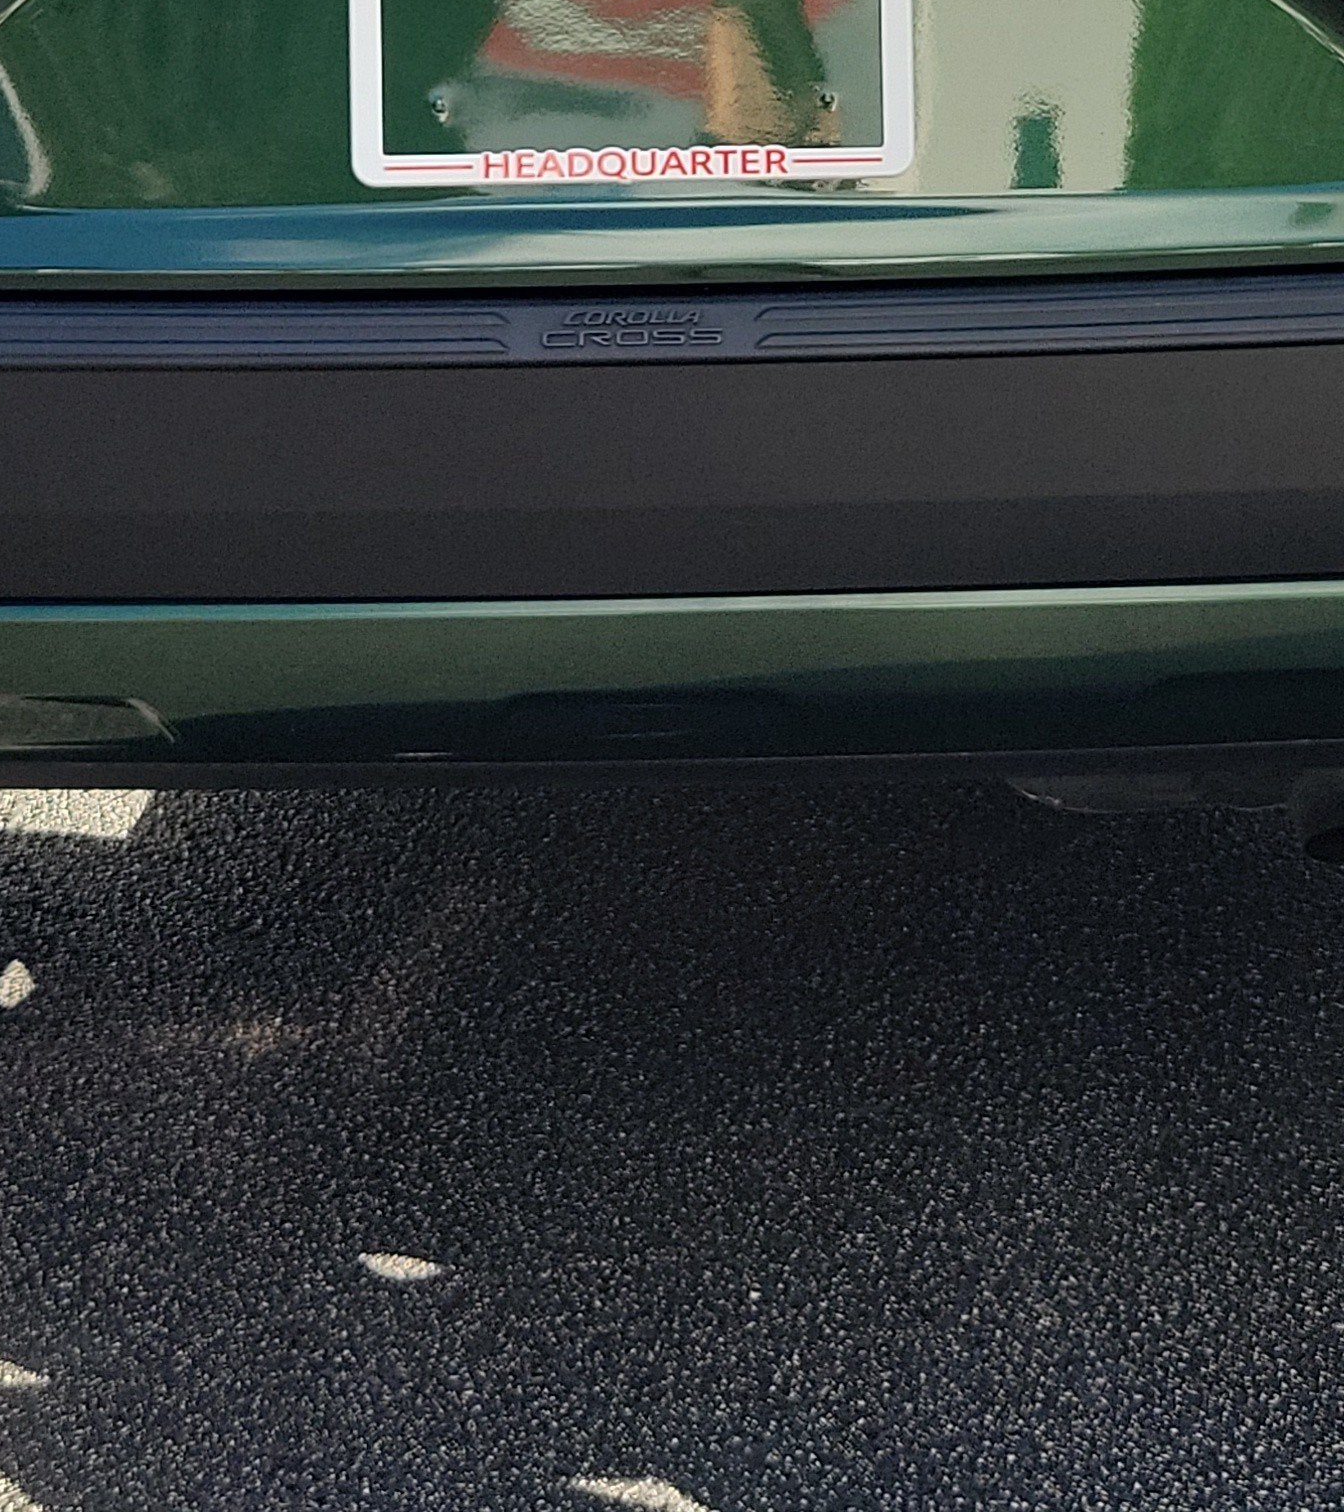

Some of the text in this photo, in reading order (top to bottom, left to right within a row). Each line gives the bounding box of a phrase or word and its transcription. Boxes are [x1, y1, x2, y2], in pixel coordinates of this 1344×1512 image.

[483, 148, 789, 180] HEADQUARTER
[563, 307, 700, 327] COROLLA
[541, 328, 724, 349] CROSS
